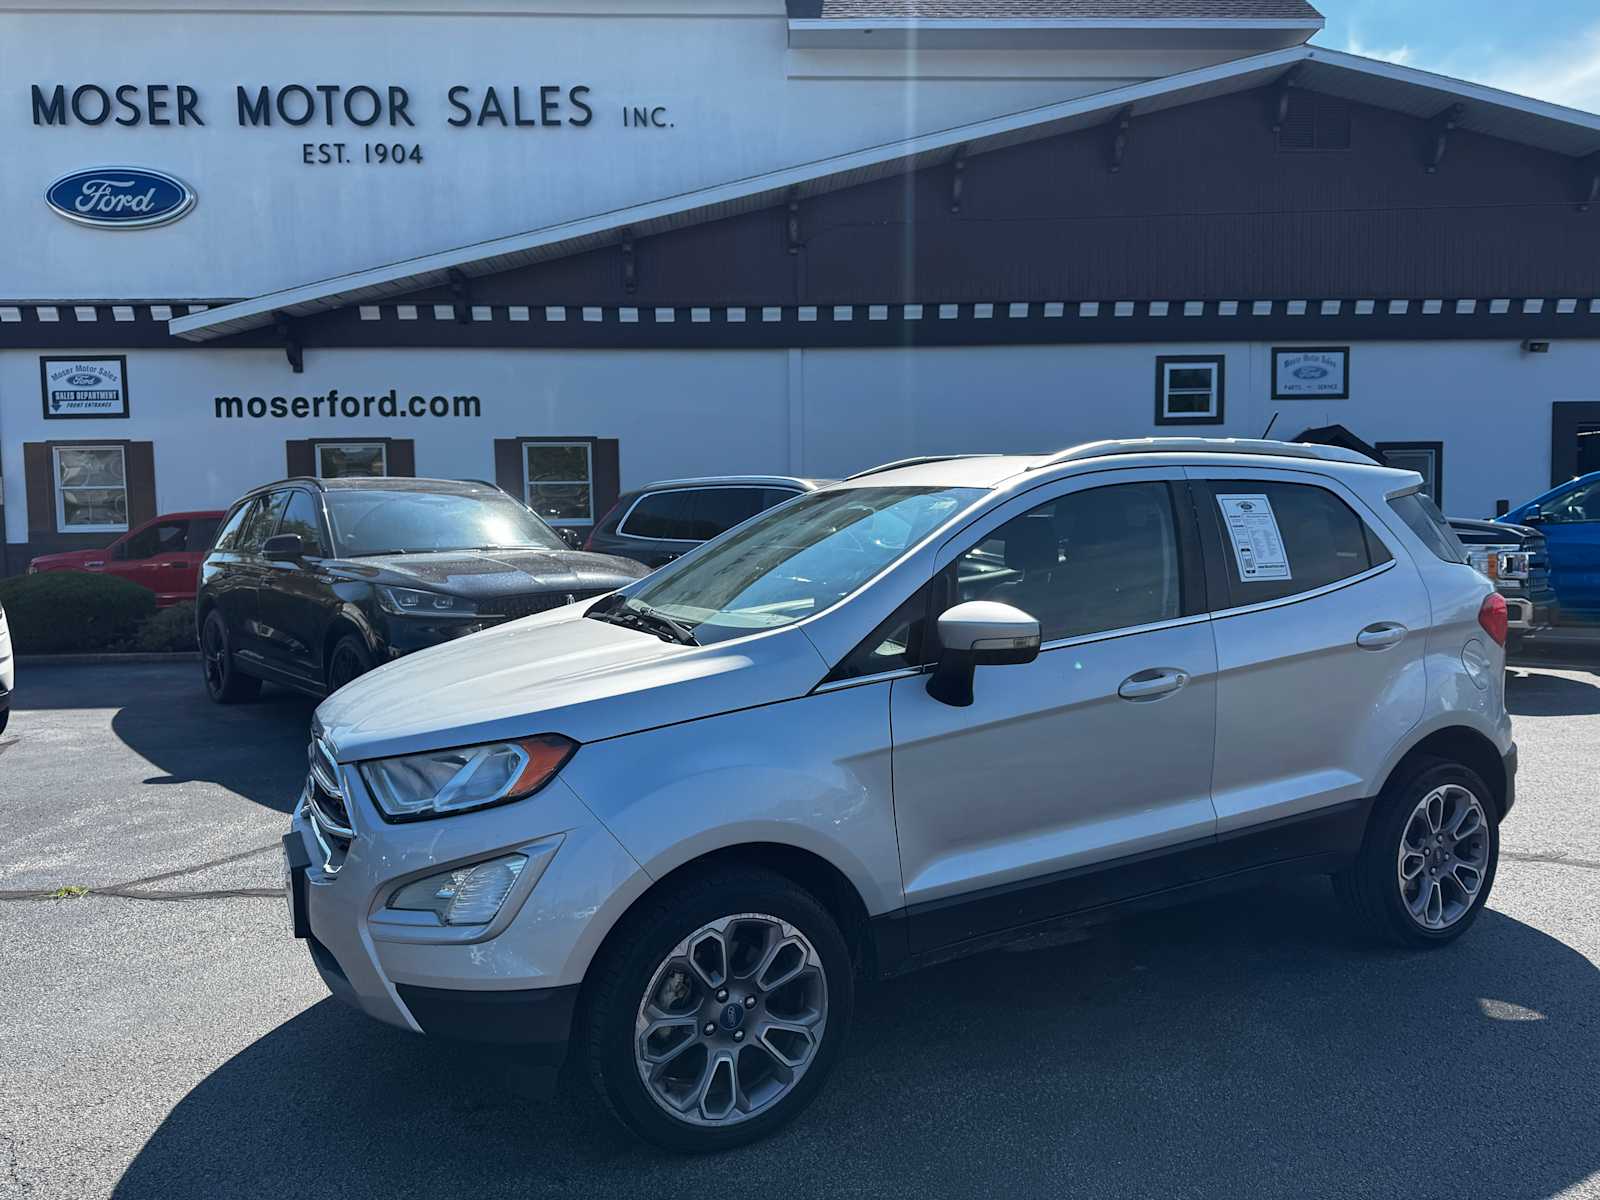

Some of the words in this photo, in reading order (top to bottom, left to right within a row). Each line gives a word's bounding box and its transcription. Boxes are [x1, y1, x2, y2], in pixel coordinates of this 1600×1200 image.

[32, 84, 205, 127] MOSER
[236, 84, 415, 127] MOTOR
[447, 85, 593, 127] SALES
[623, 106, 675, 128] INC.
[303, 143, 351, 165] EST.
[365, 143, 424, 165] 1904
[75, 179, 156, 212] Ford
[214, 389, 481, 418] moserford.com
